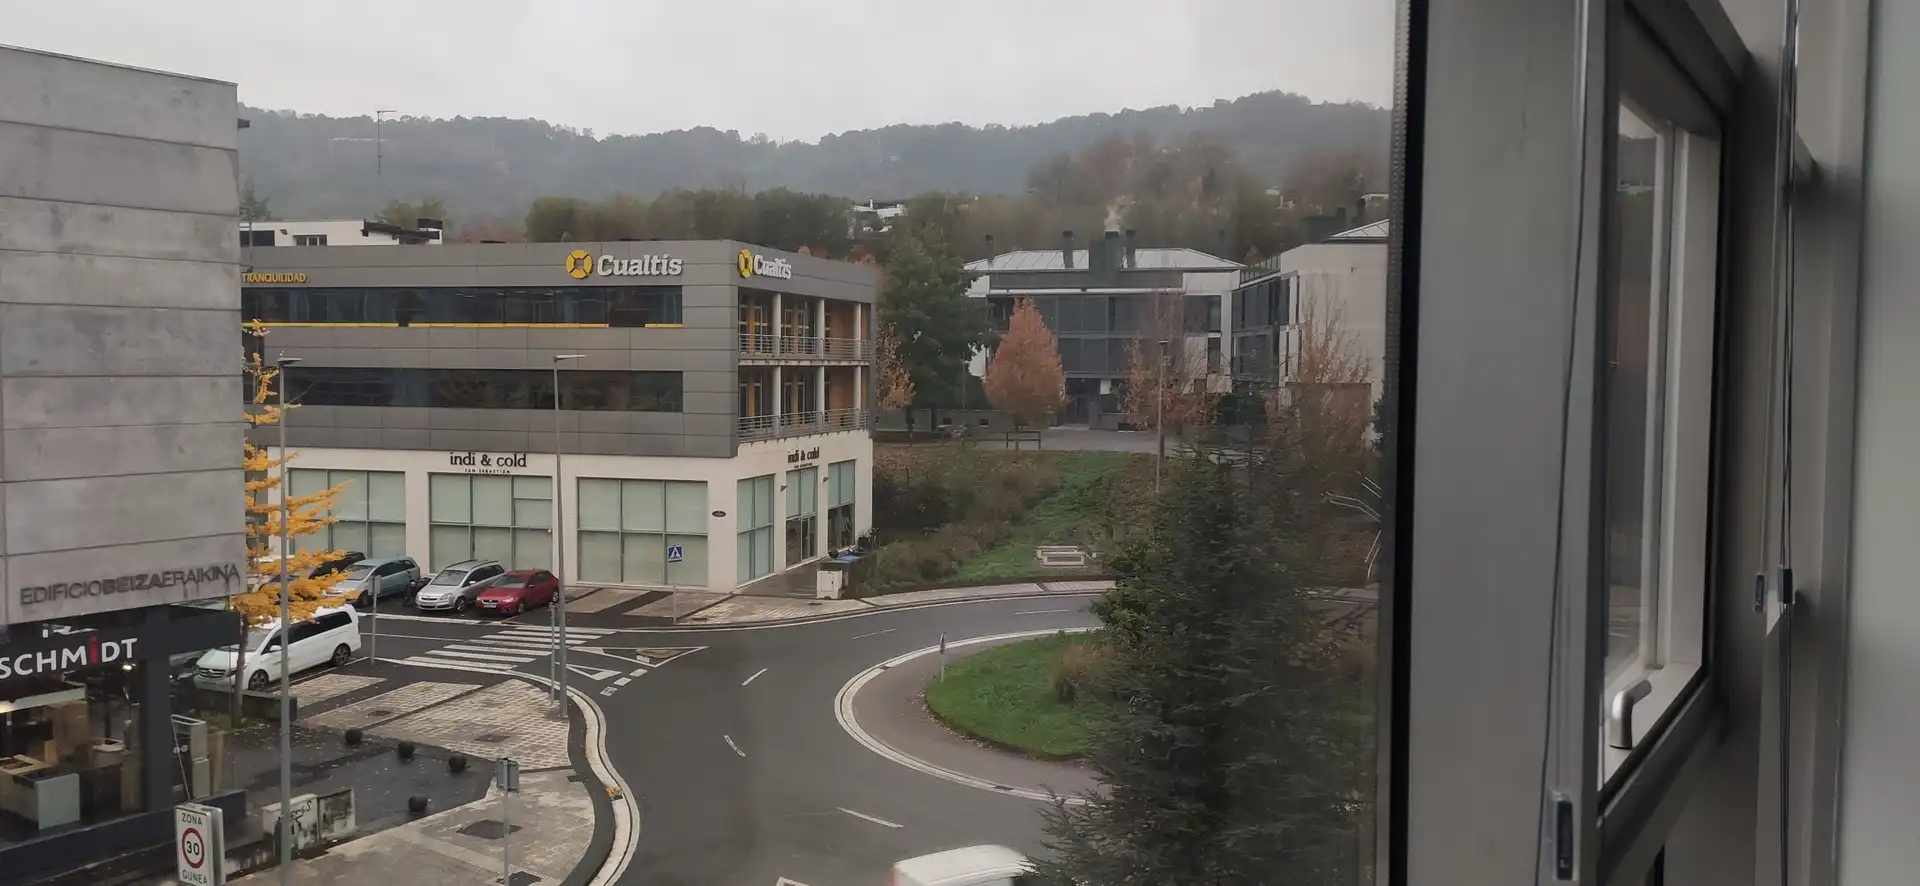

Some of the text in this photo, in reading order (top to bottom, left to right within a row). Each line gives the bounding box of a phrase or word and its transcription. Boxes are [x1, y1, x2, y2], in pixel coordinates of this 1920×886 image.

[597, 254, 683, 276] Cualtis
[754, 254, 792, 279] Cualtis
[449, 451, 527, 467] indi & cold
[181, 812, 203, 826] ZONA
[186, 840, 200, 856] 30
[182, 869, 208, 885] GUNEA
